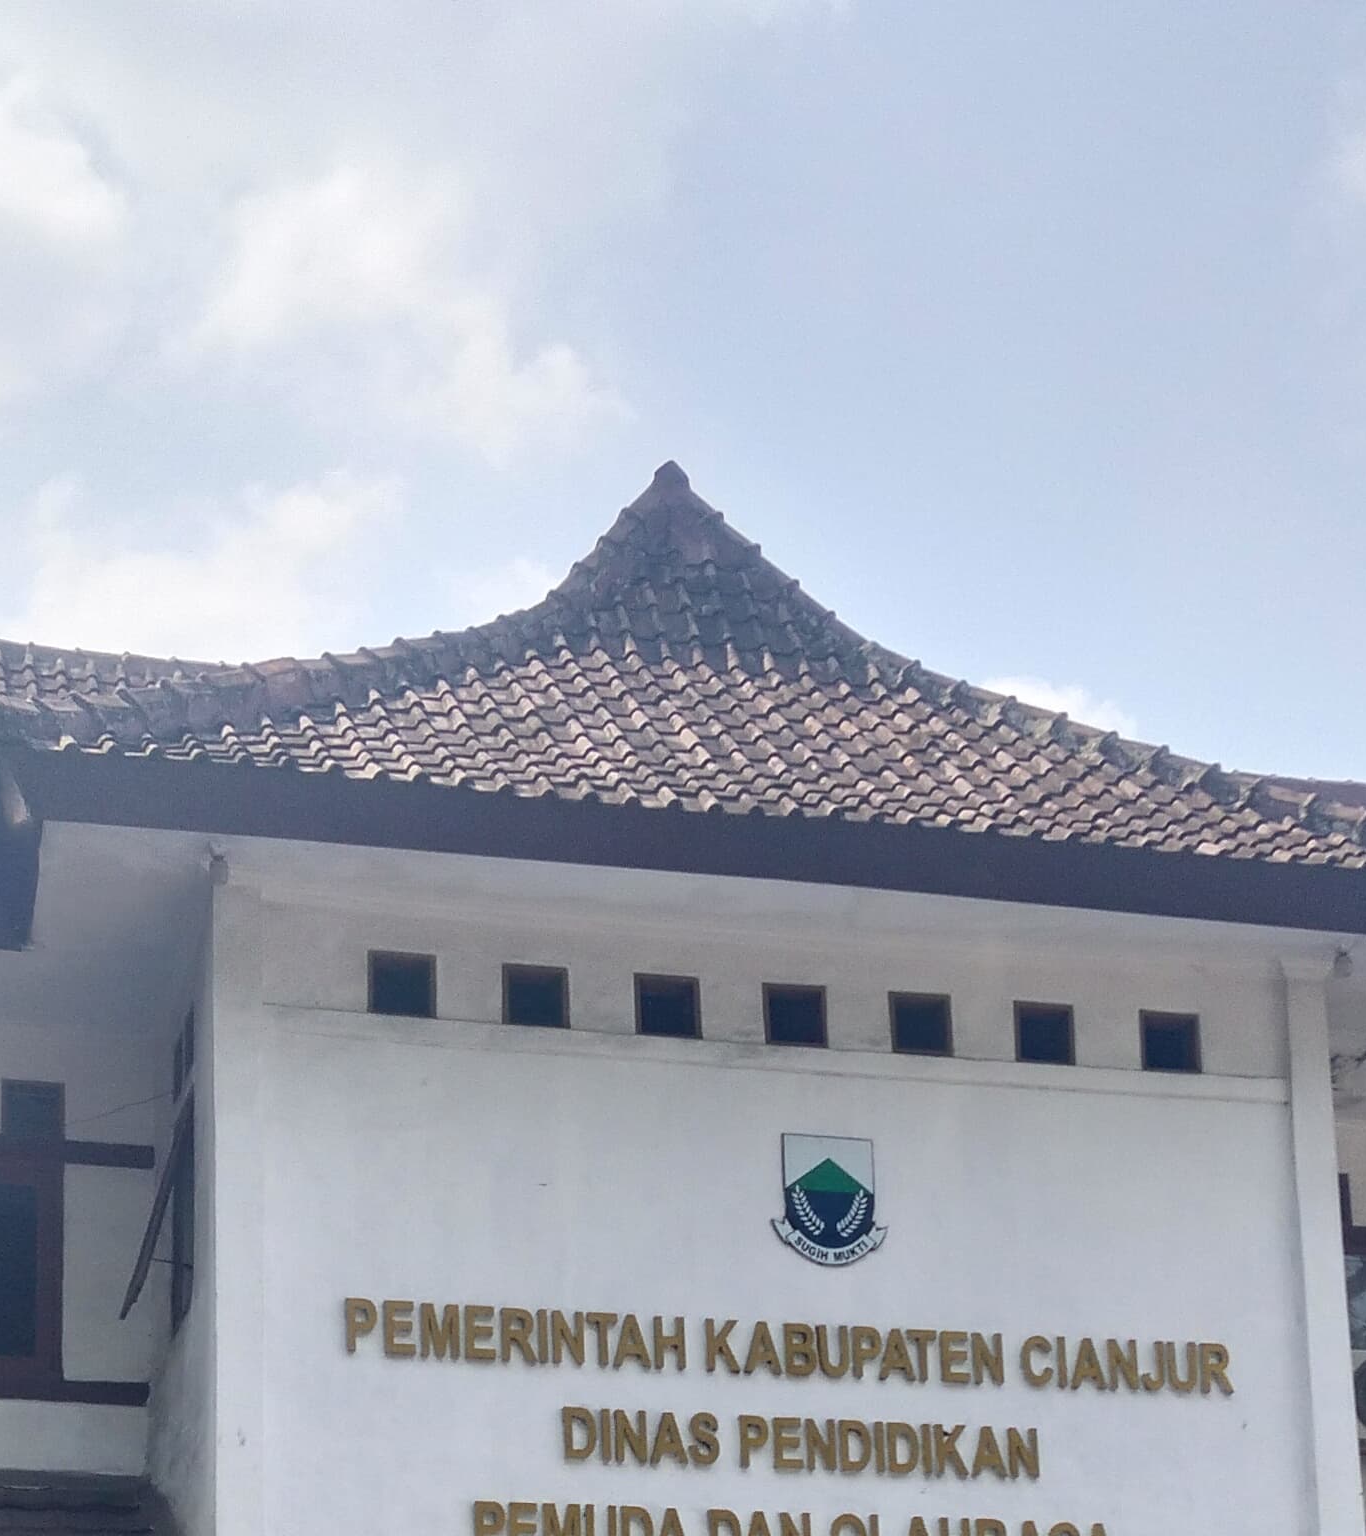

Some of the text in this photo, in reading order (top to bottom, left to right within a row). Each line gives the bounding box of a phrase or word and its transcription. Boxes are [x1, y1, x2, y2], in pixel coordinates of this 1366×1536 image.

[794, 1236, 868, 1261] SUGIH MUKTI
[344, 1297, 1235, 1395] PEMERINTAH KABUPATEN CIANJUR
[561, 1405, 1041, 1479] DINAS PENDIDIKAN
